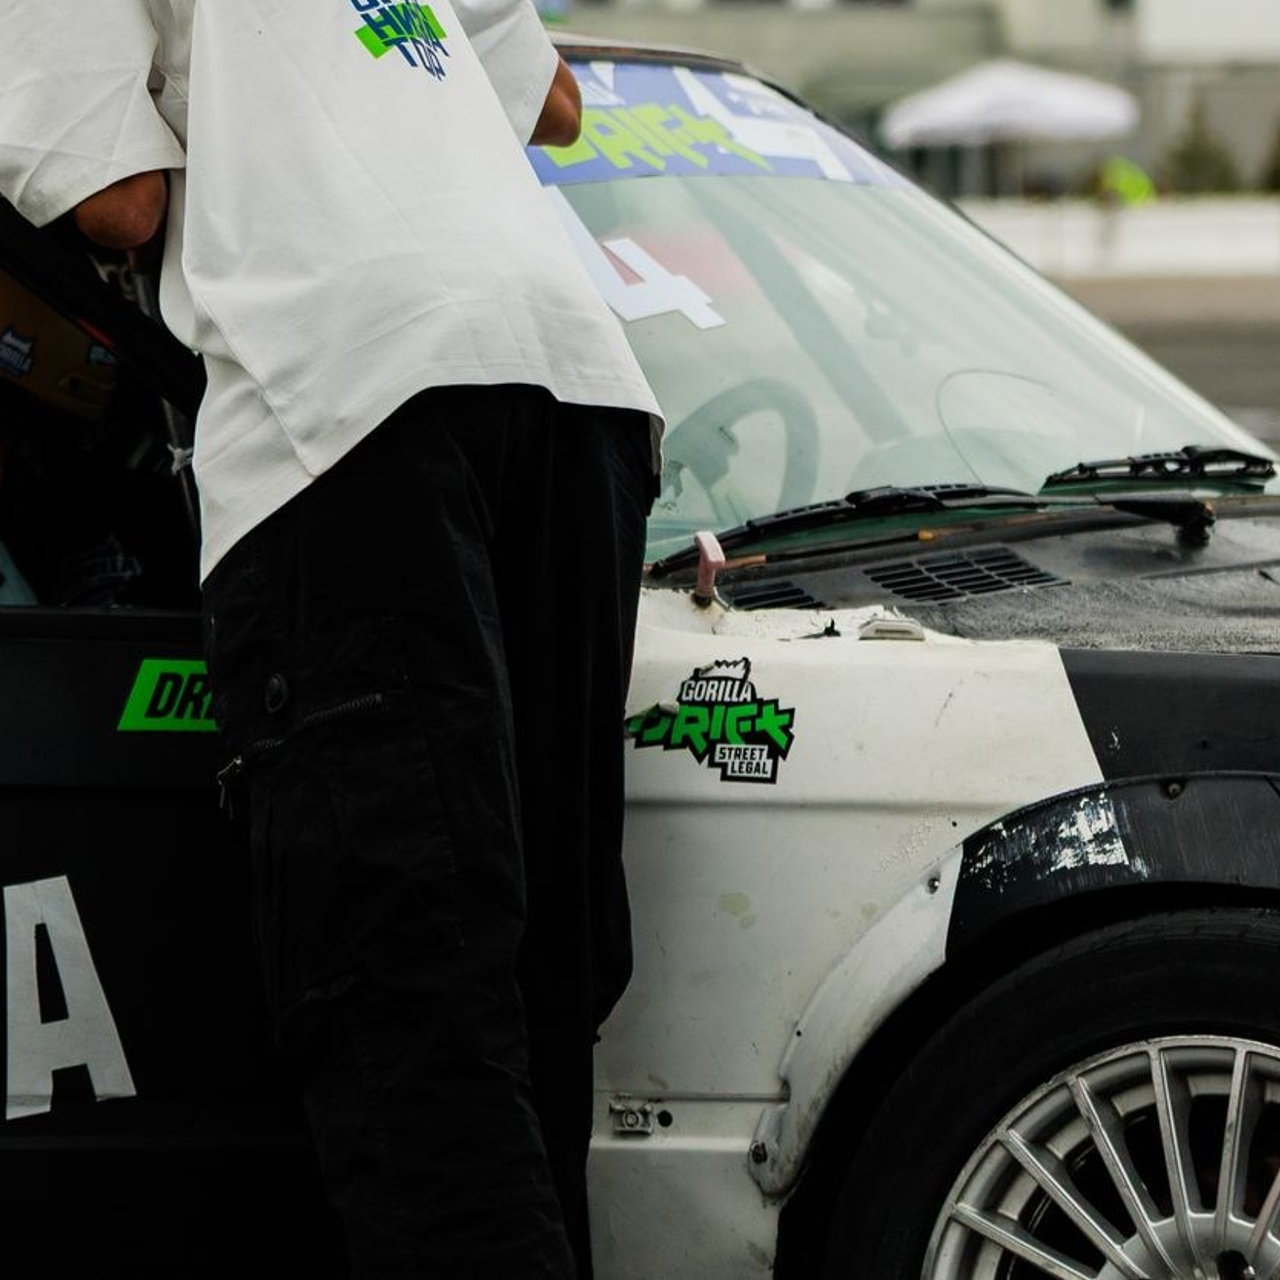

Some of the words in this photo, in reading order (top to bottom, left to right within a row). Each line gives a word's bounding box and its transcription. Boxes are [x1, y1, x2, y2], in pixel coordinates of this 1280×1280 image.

[681, 679, 752, 703] GORILLA
[718, 747, 766, 762] STREET
[730, 760, 769, 775] LEGAL
